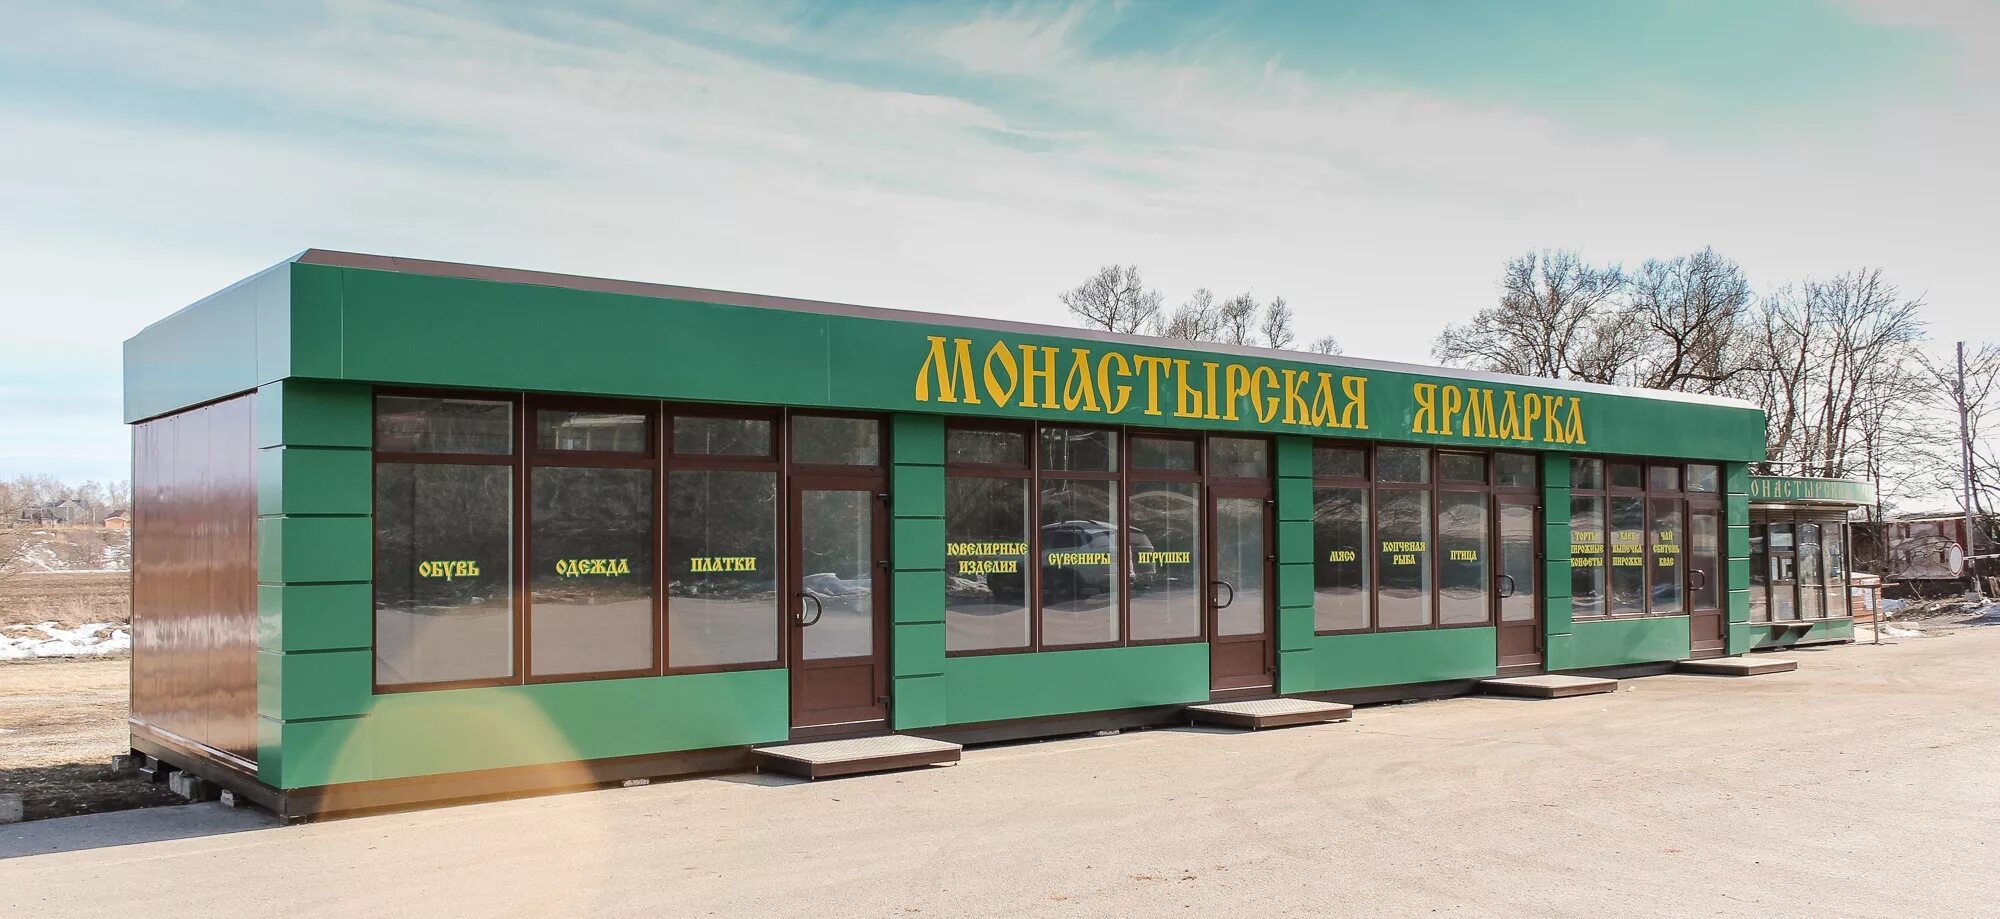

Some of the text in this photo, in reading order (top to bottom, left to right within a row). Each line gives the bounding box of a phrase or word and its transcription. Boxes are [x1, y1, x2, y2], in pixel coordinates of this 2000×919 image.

[914, 335, 1587, 445] МОНАСТЫРСКАЯ ЯРМАРКА
[1574, 531, 1598, 541] ТОРТЫ
[1660, 530, 1673, 541] ЧАЙ
[946, 542, 1028, 557] ЮВЕЛИРНЫЕ
[1382, 541, 1426, 553] КОПЧЕНАЯ
[1048, 552, 1112, 569] СУВЕНИРЫ
[1137, 551, 1190, 567] ИГРУШКИ
[1329, 550, 1356, 562] МЯСО
[1393, 554, 1416, 565] РЫБА
[1450, 550, 1478, 563] ПТИЦА
[1571, 557, 1604, 567] КОНФЕТЫ
[1612, 556, 1643, 567] ПИРОЖКИ
[1658, 557, 1675, 567] КВАС
[555, 557, 631, 579] ОДЕЖДА
[690, 556, 757, 572] ПЛАТКИ
[958, 560, 1018, 576] ИЗДЕЛИЯ
[418, 560, 481, 582] ОБУВЬ
